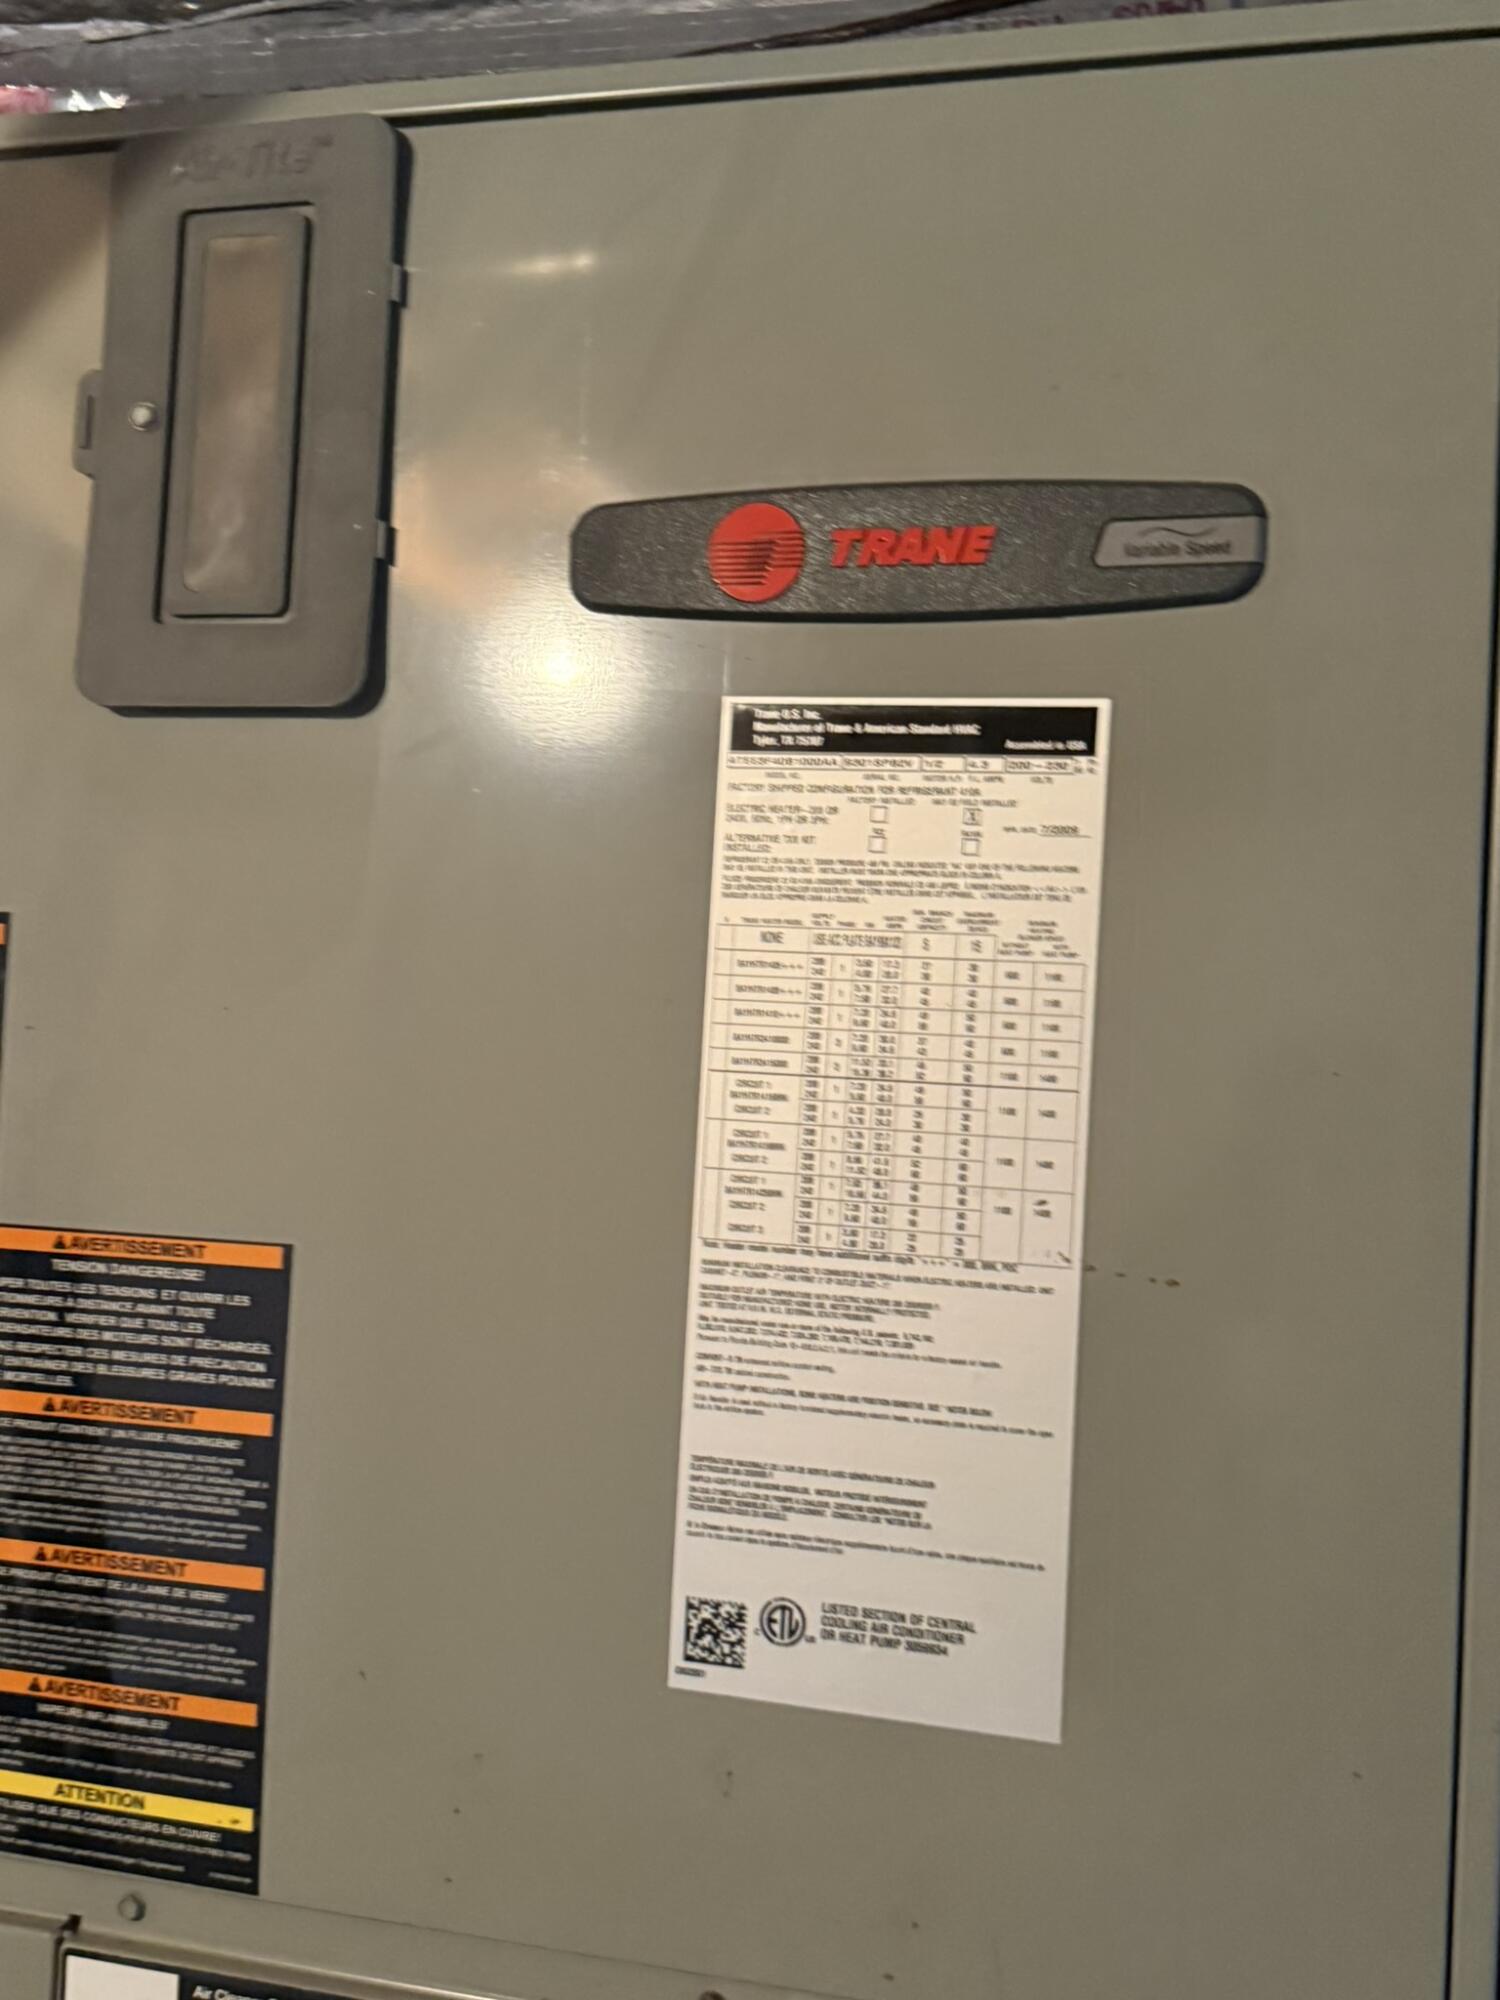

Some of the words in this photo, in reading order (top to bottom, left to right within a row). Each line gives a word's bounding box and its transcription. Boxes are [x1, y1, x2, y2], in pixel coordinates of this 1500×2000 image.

[829, 524, 996, 567] TRANE
[70, 1236, 207, 1259] AVERTISSEMENT
[58, 1399, 196, 1425] AVERTISSEMENT
[49, 1548, 189, 1578] AVERTISSEMENT
[820, 1615, 868, 1632] COOLING
[870, 1622, 889, 1635] AIR
[891, 1624, 966, 1646] CONDITIONER
[821, 1602, 858, 1617] LISTED
[861, 1606, 907, 1624] SECTION
[909, 1613, 924, 1626] OF
[926, 1615, 977, 1634] CENTRAL
[820, 1628, 836, 1641] OR
[838, 1631, 866, 1645] HEAT
[870, 1635, 901, 1650] PUMP
[43, 1679, 182, 1711] AVERTISSEMENT
[54, 1783, 147, 1811] ATTENTION
